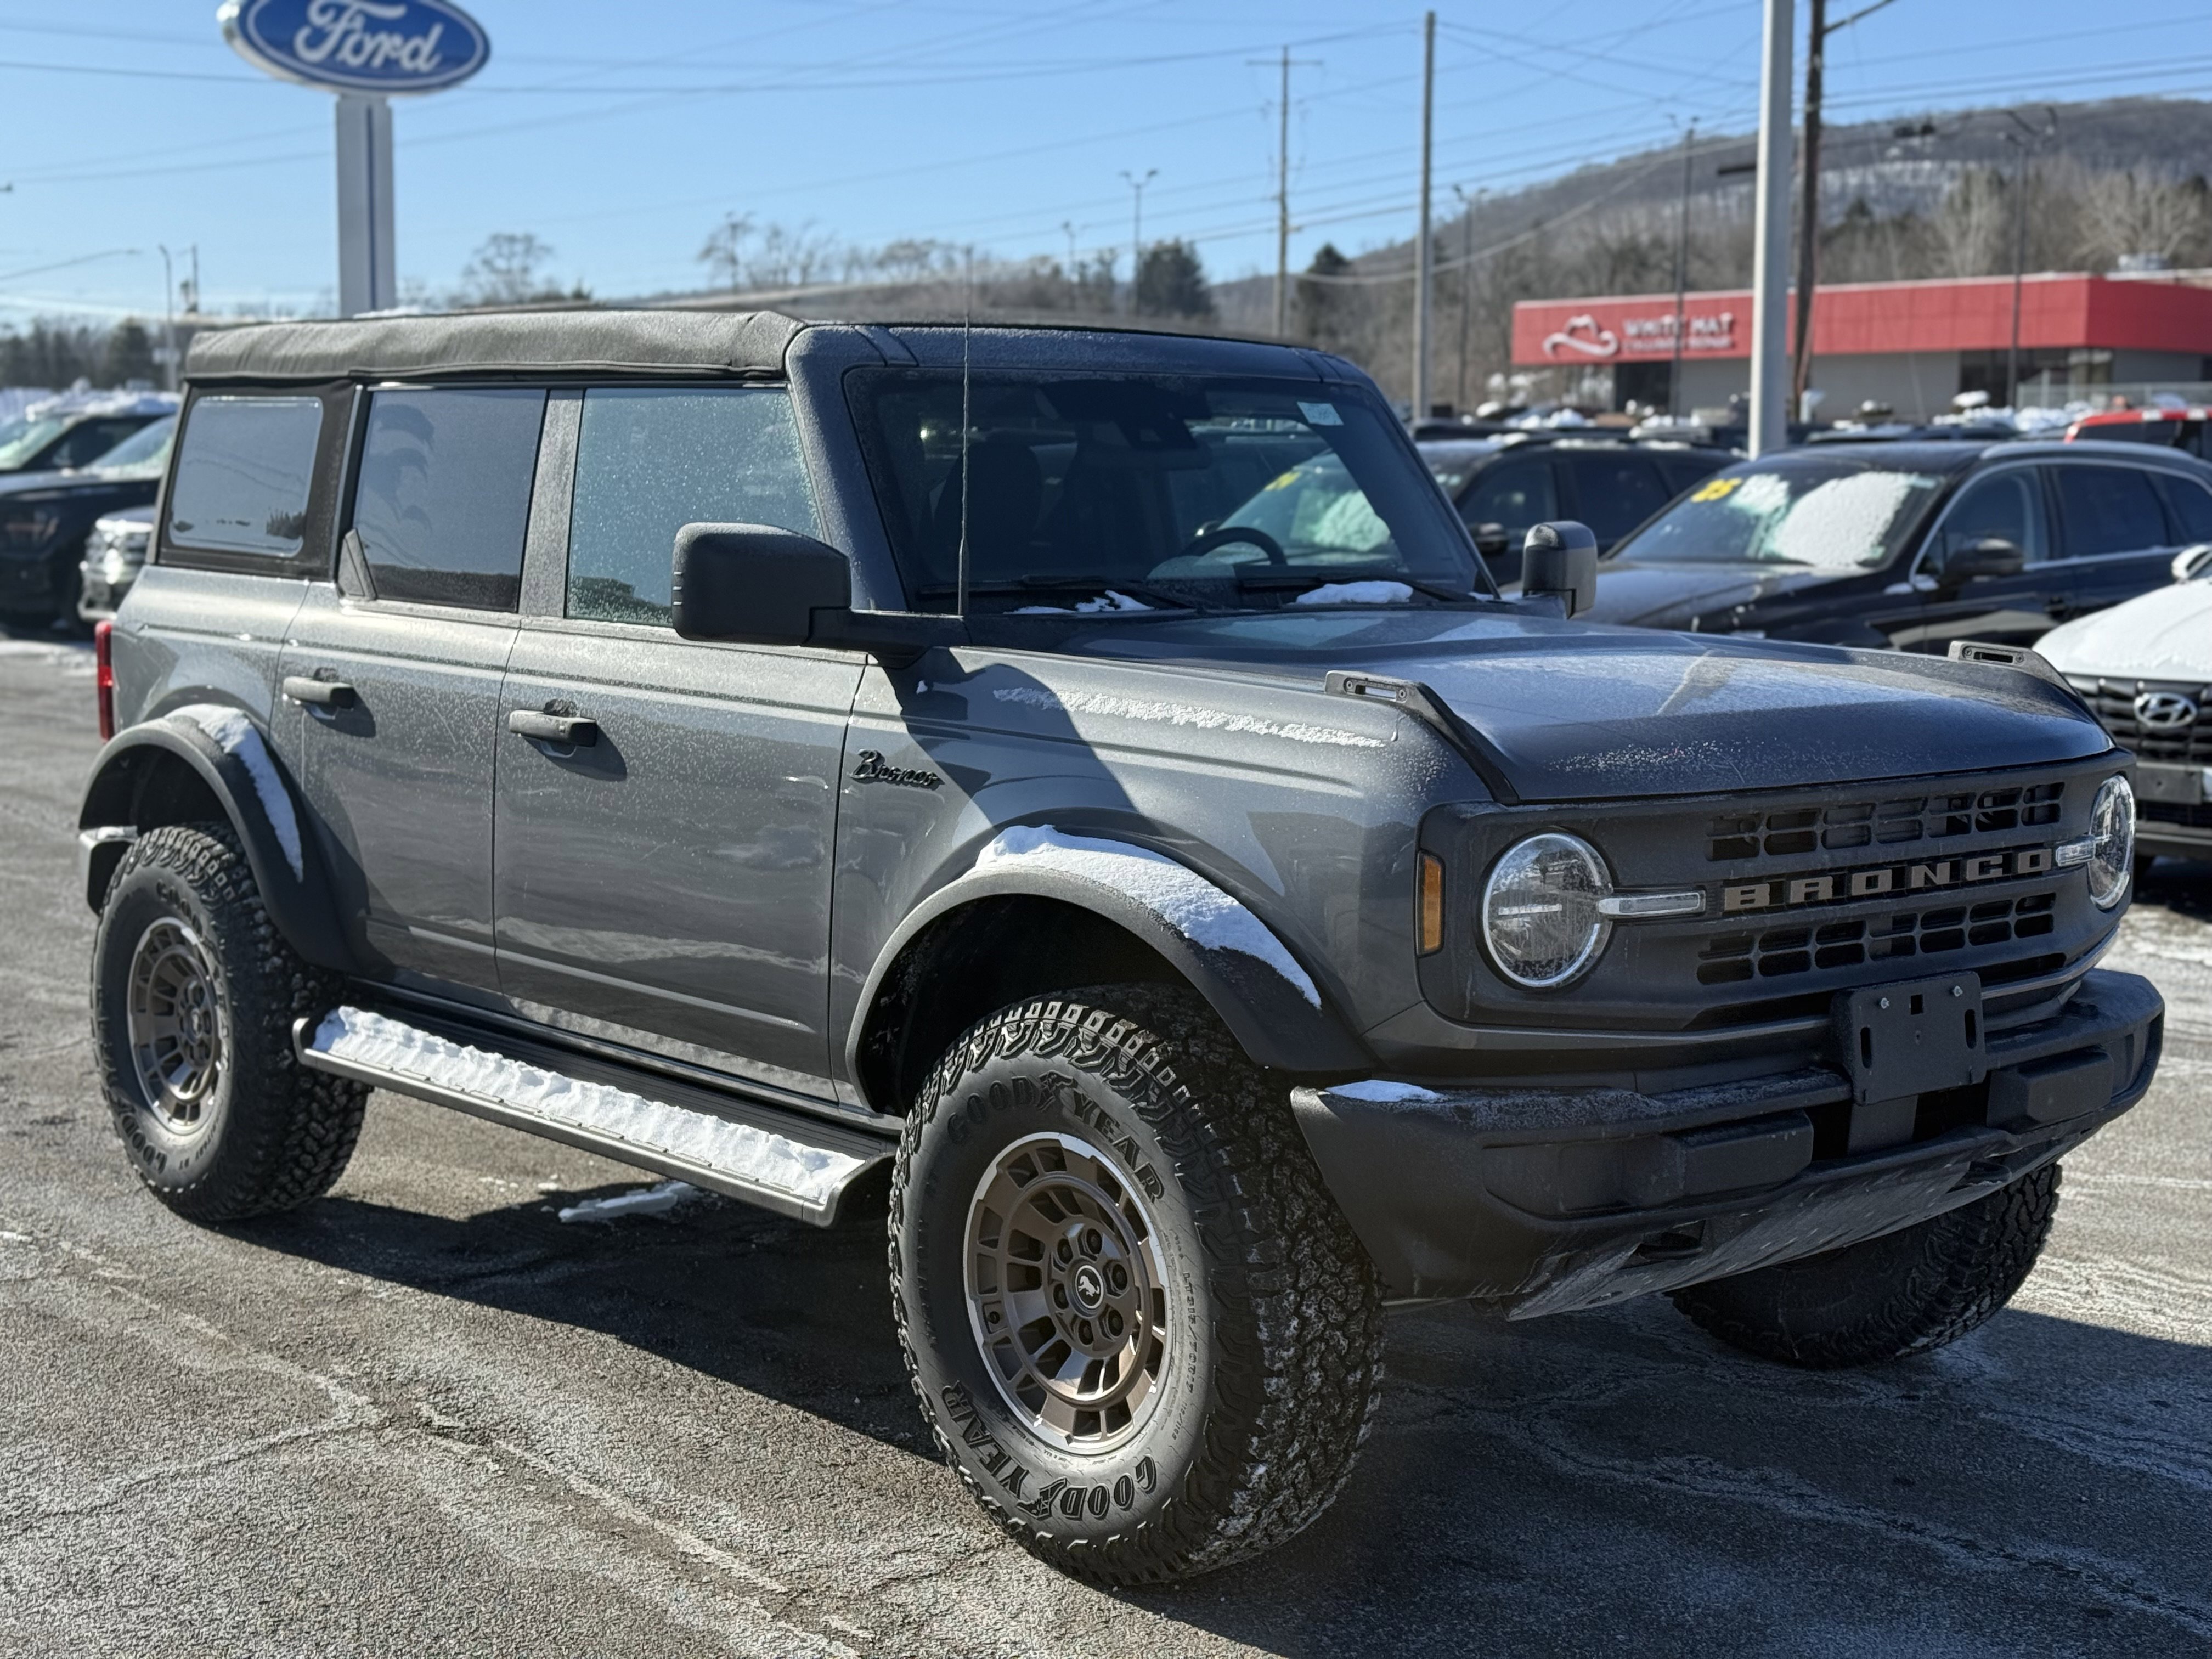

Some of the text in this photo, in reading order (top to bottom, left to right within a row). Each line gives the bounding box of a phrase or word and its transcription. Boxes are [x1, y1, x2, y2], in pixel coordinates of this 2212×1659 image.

[294, 0, 443, 72] Ford
[850, 748, 942, 788] Bronco
[1724, 848, 2052, 911] BRONCO
